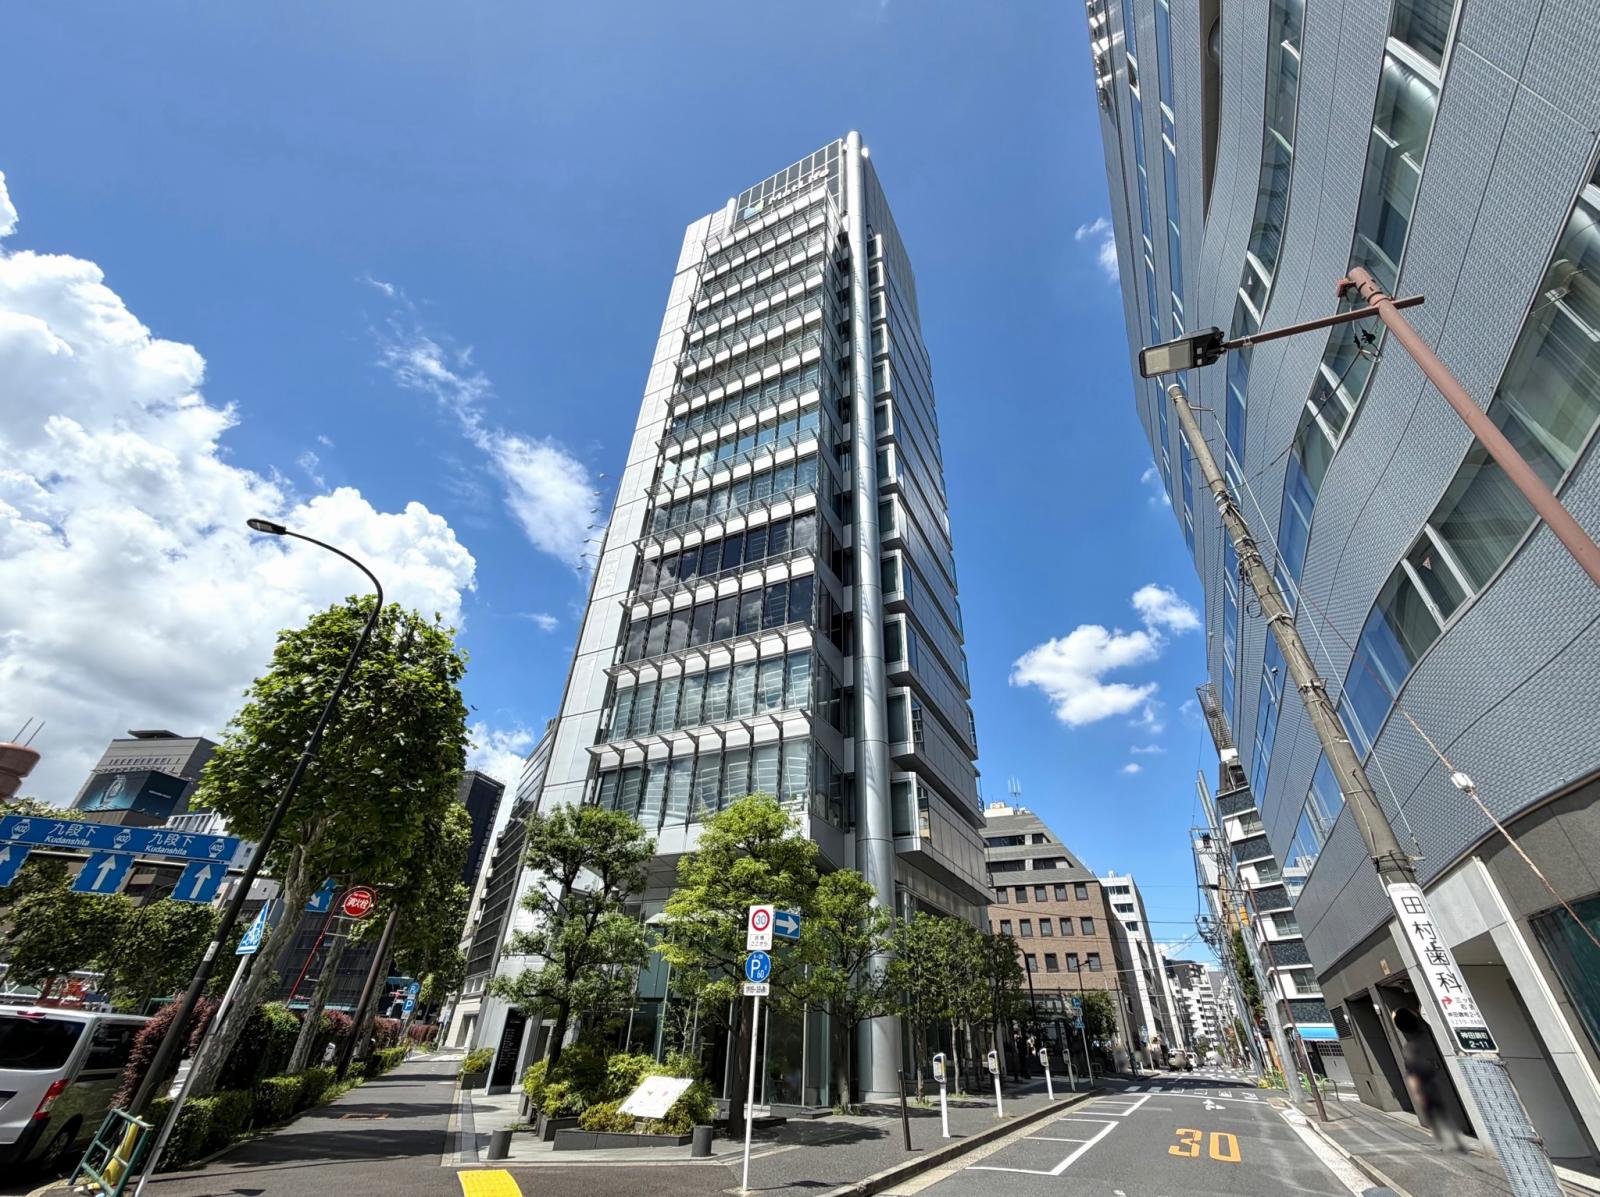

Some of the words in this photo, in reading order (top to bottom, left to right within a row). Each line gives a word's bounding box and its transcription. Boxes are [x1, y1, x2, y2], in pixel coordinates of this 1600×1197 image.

[48, 821, 101, 838] 九段下
[44, 835, 90, 847] Kudanshita
[147, 831, 196, 848] 九段下
[144, 844, 188, 856] Kudanshita
[755, 914, 767, 926] 30
[1401, 896, 1463, 993] 田村歯科
[750, 959, 761, 978] P
[756, 970, 765, 979] 60
[1468, 1040, 1490, 1049] 2-11
[1168, 1128, 1242, 1163] 30
